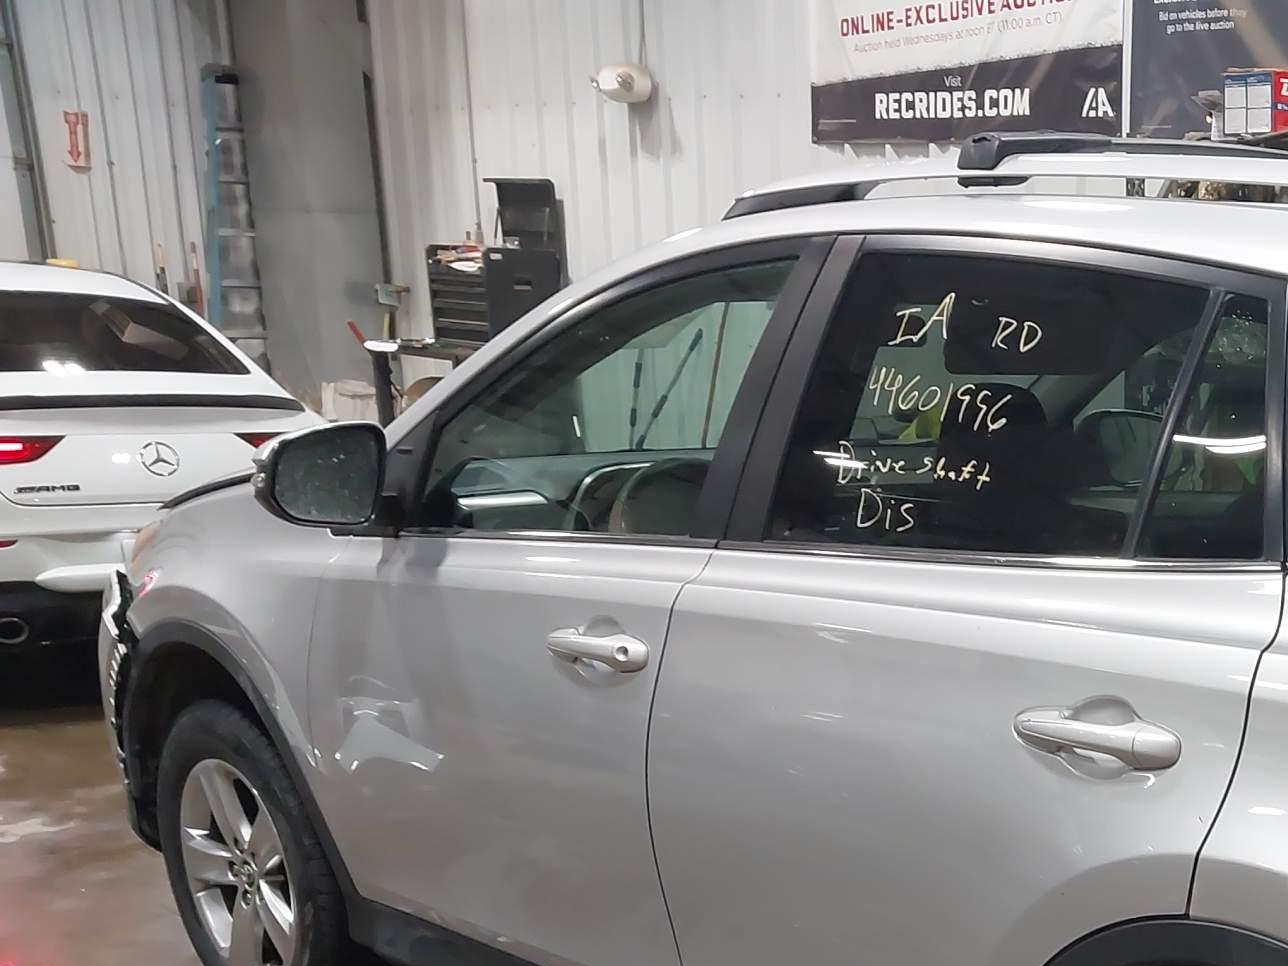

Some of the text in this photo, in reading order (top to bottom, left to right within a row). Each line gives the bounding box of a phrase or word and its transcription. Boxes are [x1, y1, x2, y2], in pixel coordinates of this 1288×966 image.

[840, 0, 996, 37] ONLINE-EXCLUSIVE
[1159, 11, 1169, 21] Bid
[1178, 9, 1206, 20] vehicles
[1207, 8, 1228, 18] before
[1166, 25, 1175, 35] go
[1183, 23, 1194, 32] the
[1196, 21, 1209, 31] live
[1210, 20, 1235, 30] auction
[944, 75, 962, 87] Visit
[874, 88, 1031, 120] RECRIDES.COM
[992, 316, 1042, 353] RD
[869, 366, 1012, 433] 44601996
